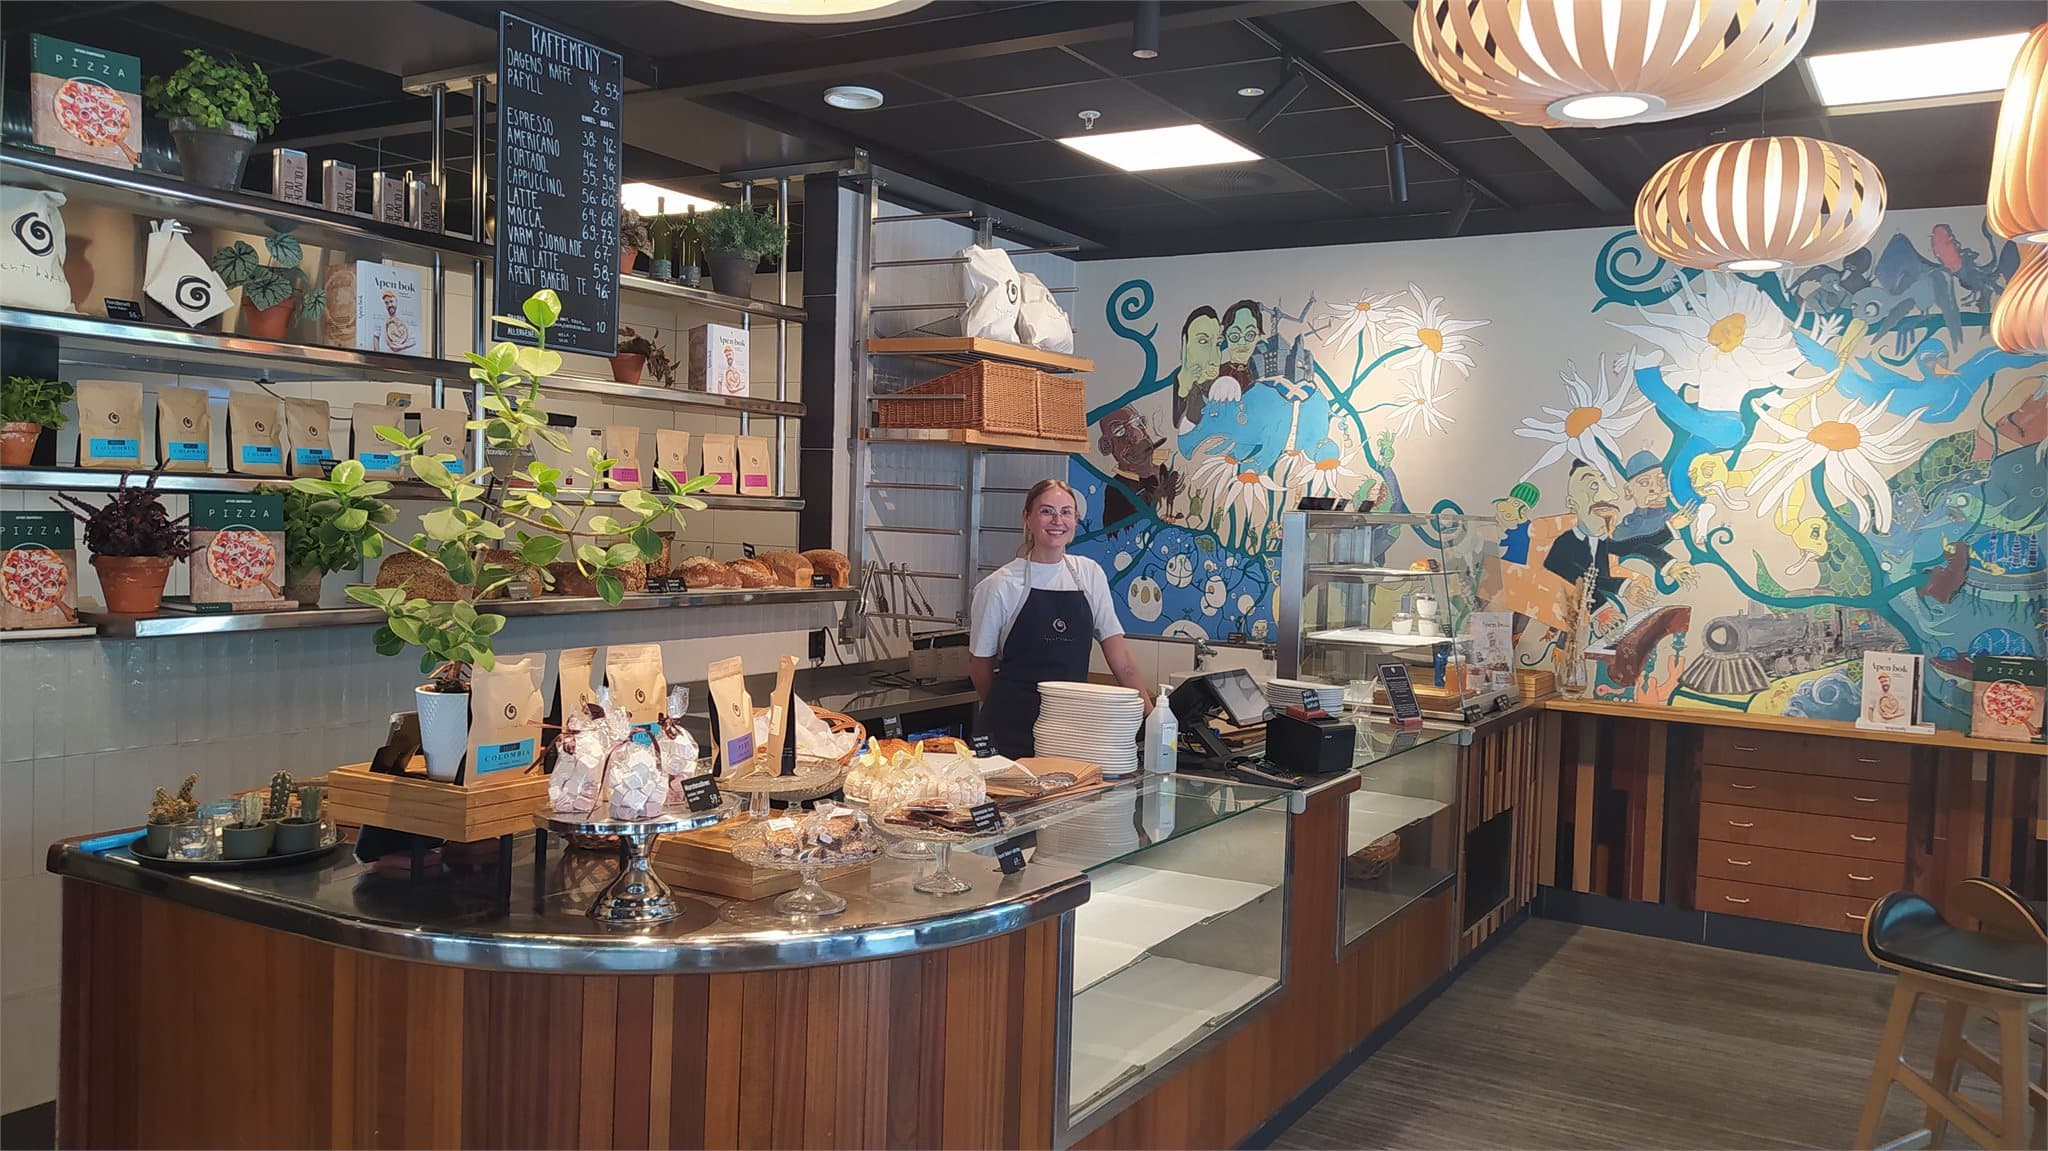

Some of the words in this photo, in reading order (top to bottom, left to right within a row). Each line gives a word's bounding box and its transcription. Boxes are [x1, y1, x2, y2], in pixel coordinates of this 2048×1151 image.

[531, 26, 600, 75] KAFFEMENY
[55, 54, 126, 78] PIZZA
[507, 47, 543, 75] DAGENS
[548, 63, 573, 86] KAFFE
[507, 69, 543, 95] PÅFYLL
[507, 106, 554, 136] ESPRESSO
[507, 127, 560, 157] AMERICANO
[507, 224, 534, 246] VARM
[507, 243, 528, 264] CHAI
[398, 281, 416, 293] bok
[508, 262, 536, 286] ÅPENT
[541, 270, 569, 292] BAKERI
[575, 276, 588, 296] TE
[208, 508, 270, 518] PIZZA
[0, 526, 62, 536] PIZZA
[1892, 664, 1908, 673] bok
[1986, 666, 2035, 677] PIZZA
[484, 750, 530, 762] COLOMBIA
